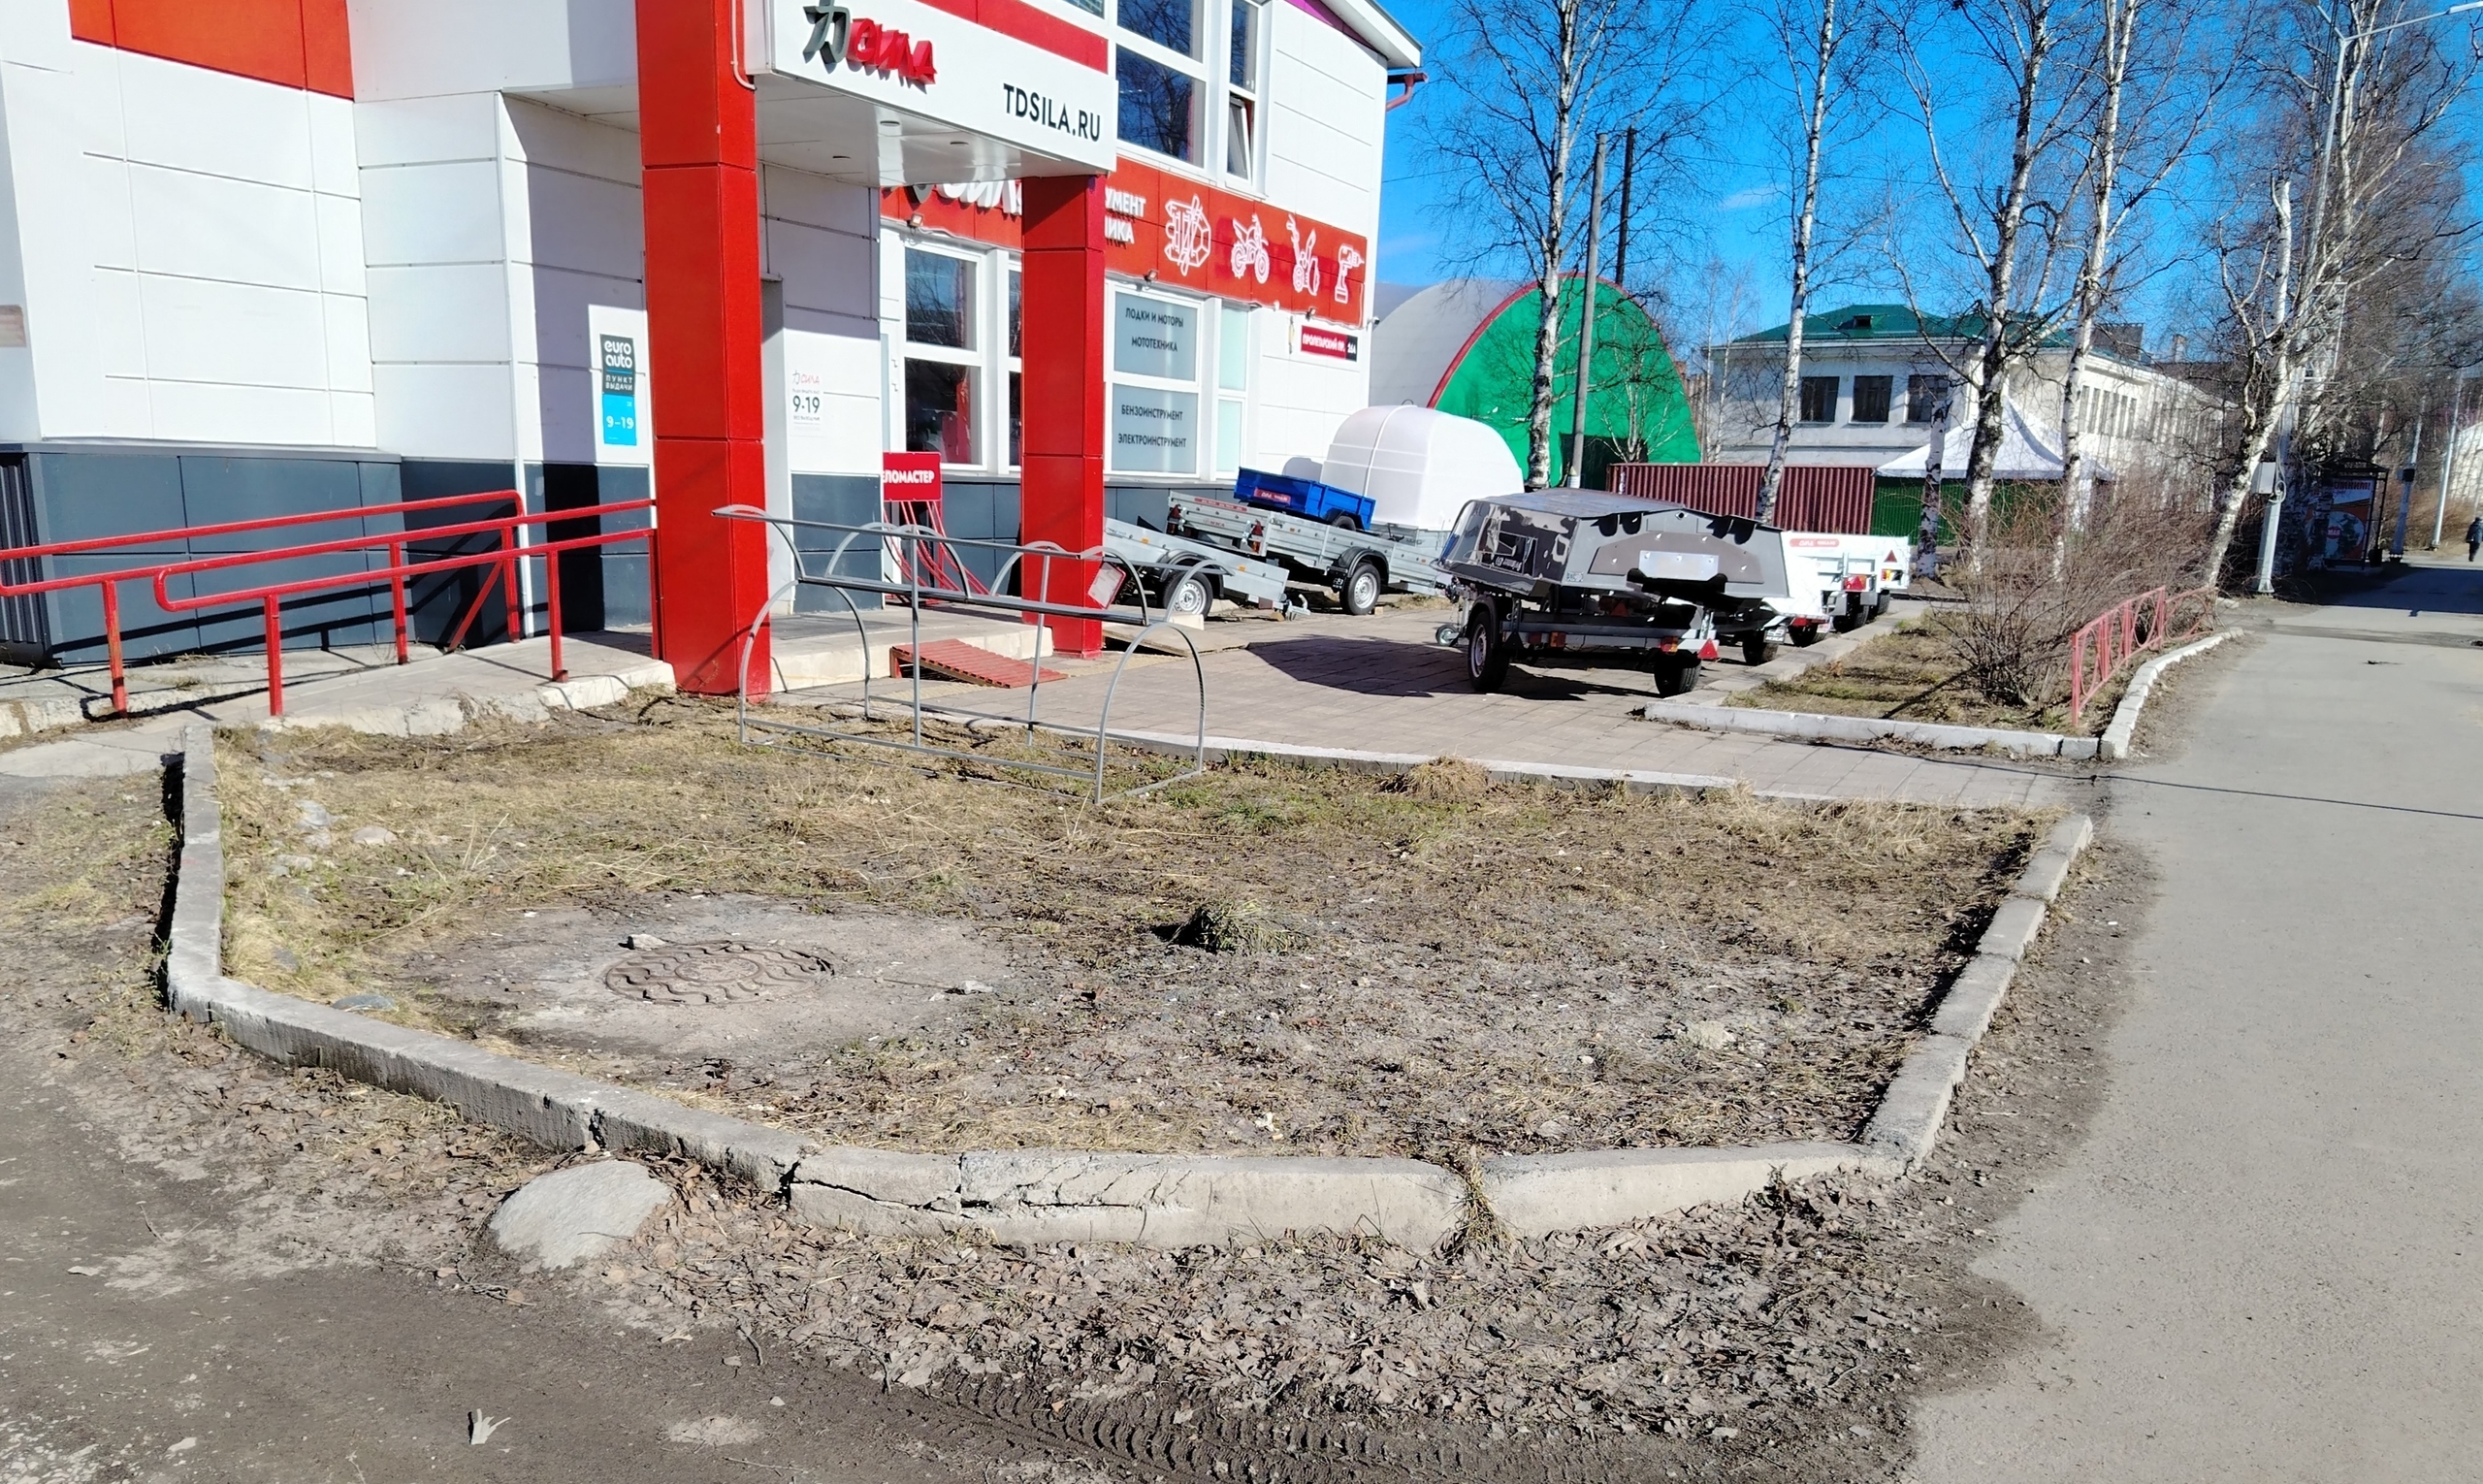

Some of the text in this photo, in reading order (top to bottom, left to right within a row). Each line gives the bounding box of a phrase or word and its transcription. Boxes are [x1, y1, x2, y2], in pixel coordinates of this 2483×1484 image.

[1003, 82, 1101, 143] TDSILA.RU
[1125, 307, 1184, 328] ЛОДКИ И МОТОРЫ
[604, 340, 632, 355] euro
[1131, 336, 1178, 352] МОТОТЕХНИКА
[605, 354, 633, 369] auto
[606, 374, 633, 384] ПУНКТ
[605, 382, 633, 392] ВЫДАЧИ
[1121, 403, 1183, 421] БЕНЗОИНСТРУМЕНТ
[606, 415, 634, 430] 9-19
[1117, 433, 1187, 448] ЭЛЕКТРОИНСТРУМЕНТ
